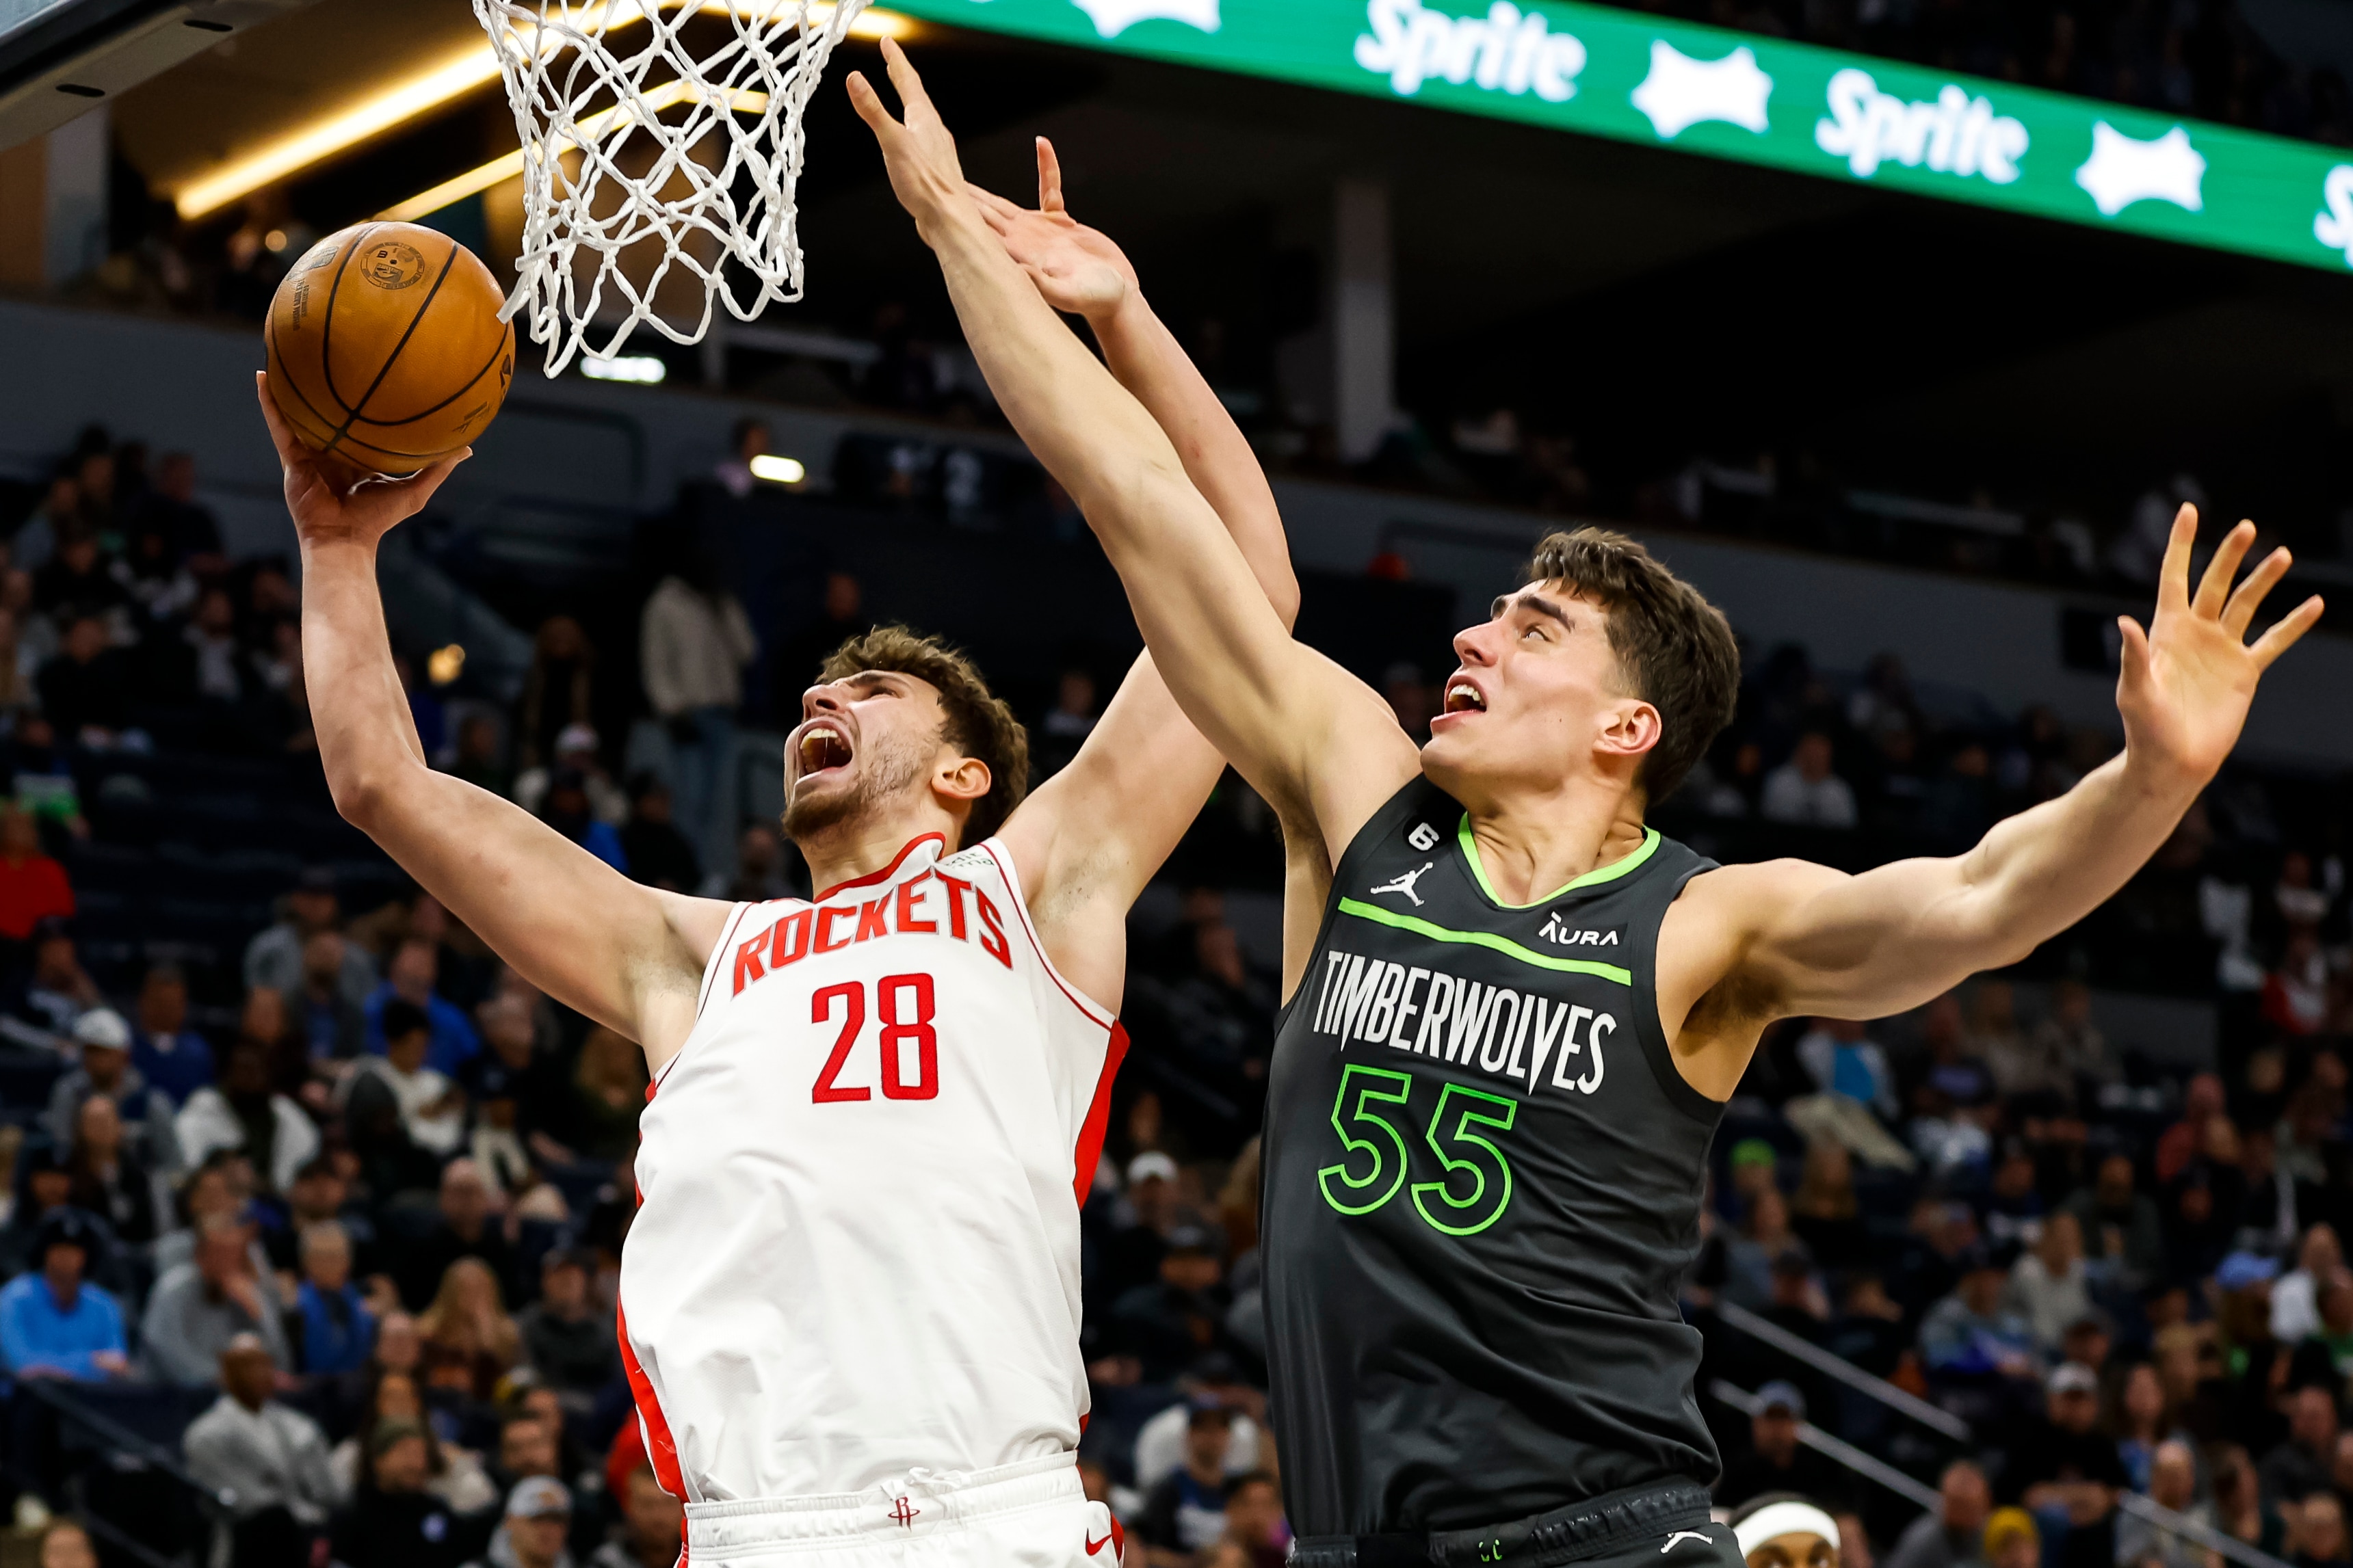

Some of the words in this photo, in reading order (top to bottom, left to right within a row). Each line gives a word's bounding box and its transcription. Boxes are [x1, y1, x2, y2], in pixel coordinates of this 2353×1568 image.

[1354, 0, 1586, 101] Sprite
[1815, 68, 2029, 183] Sprite
[1408, 823, 1440, 851] 6
[731, 865, 1014, 1001] ROCKETS
[1538, 911, 1619, 946] AURA
[811, 972, 939, 1104] 28
[1313, 951, 1617, 1096] TIMBERWOLVES
[1317, 1063, 1518, 1236] 55
